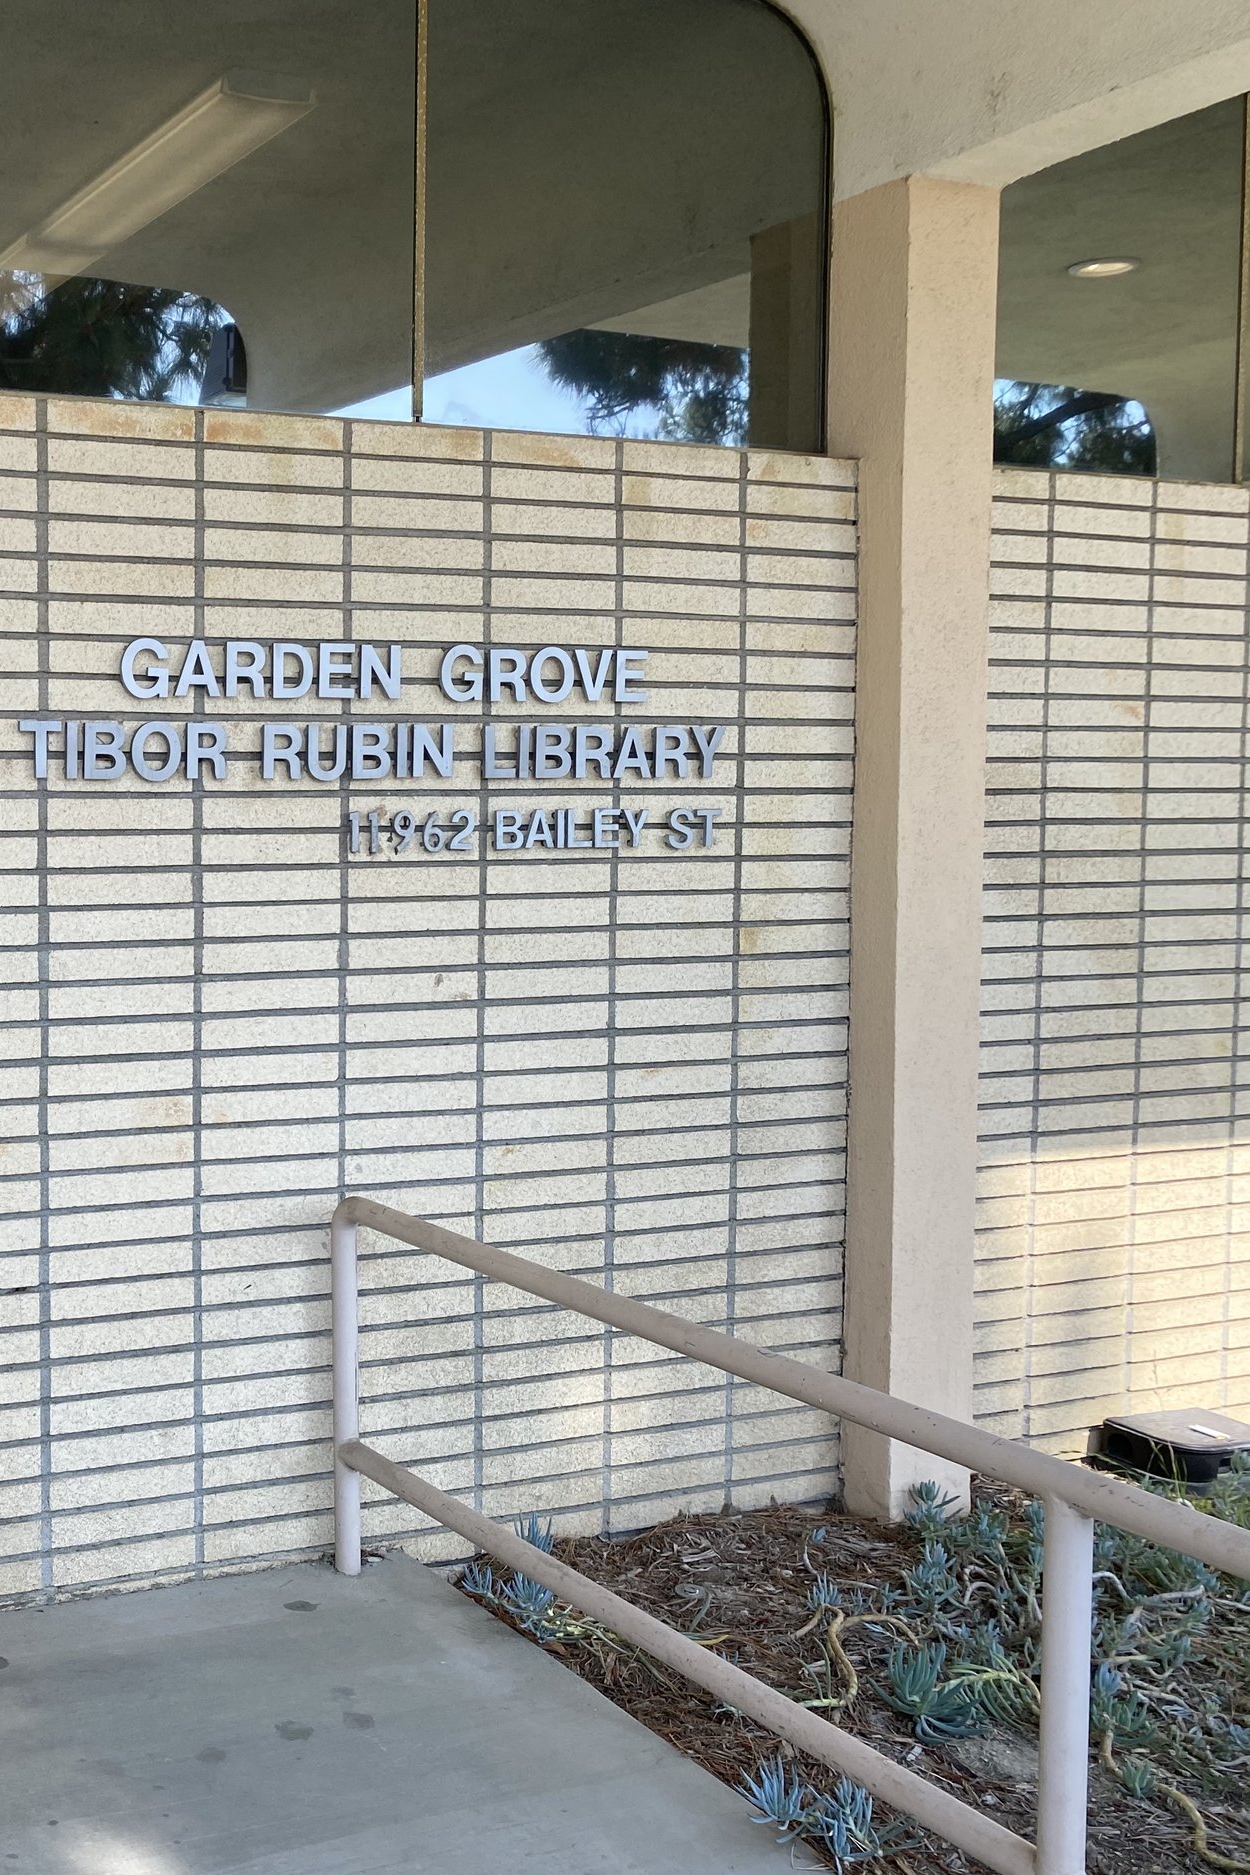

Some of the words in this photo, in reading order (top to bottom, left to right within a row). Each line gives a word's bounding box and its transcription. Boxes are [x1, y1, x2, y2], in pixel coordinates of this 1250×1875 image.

[120, 637, 401, 699] GARDEN
[439, 644, 649, 703] GROVE
[19, 719, 227, 782] TIBOR
[262, 722, 453, 782] RUBIN
[483, 724, 725, 779] LIBRARY
[349, 809, 476, 854] 11962
[494, 808, 649, 850] BAILEY
[667, 808, 722, 849] ST
